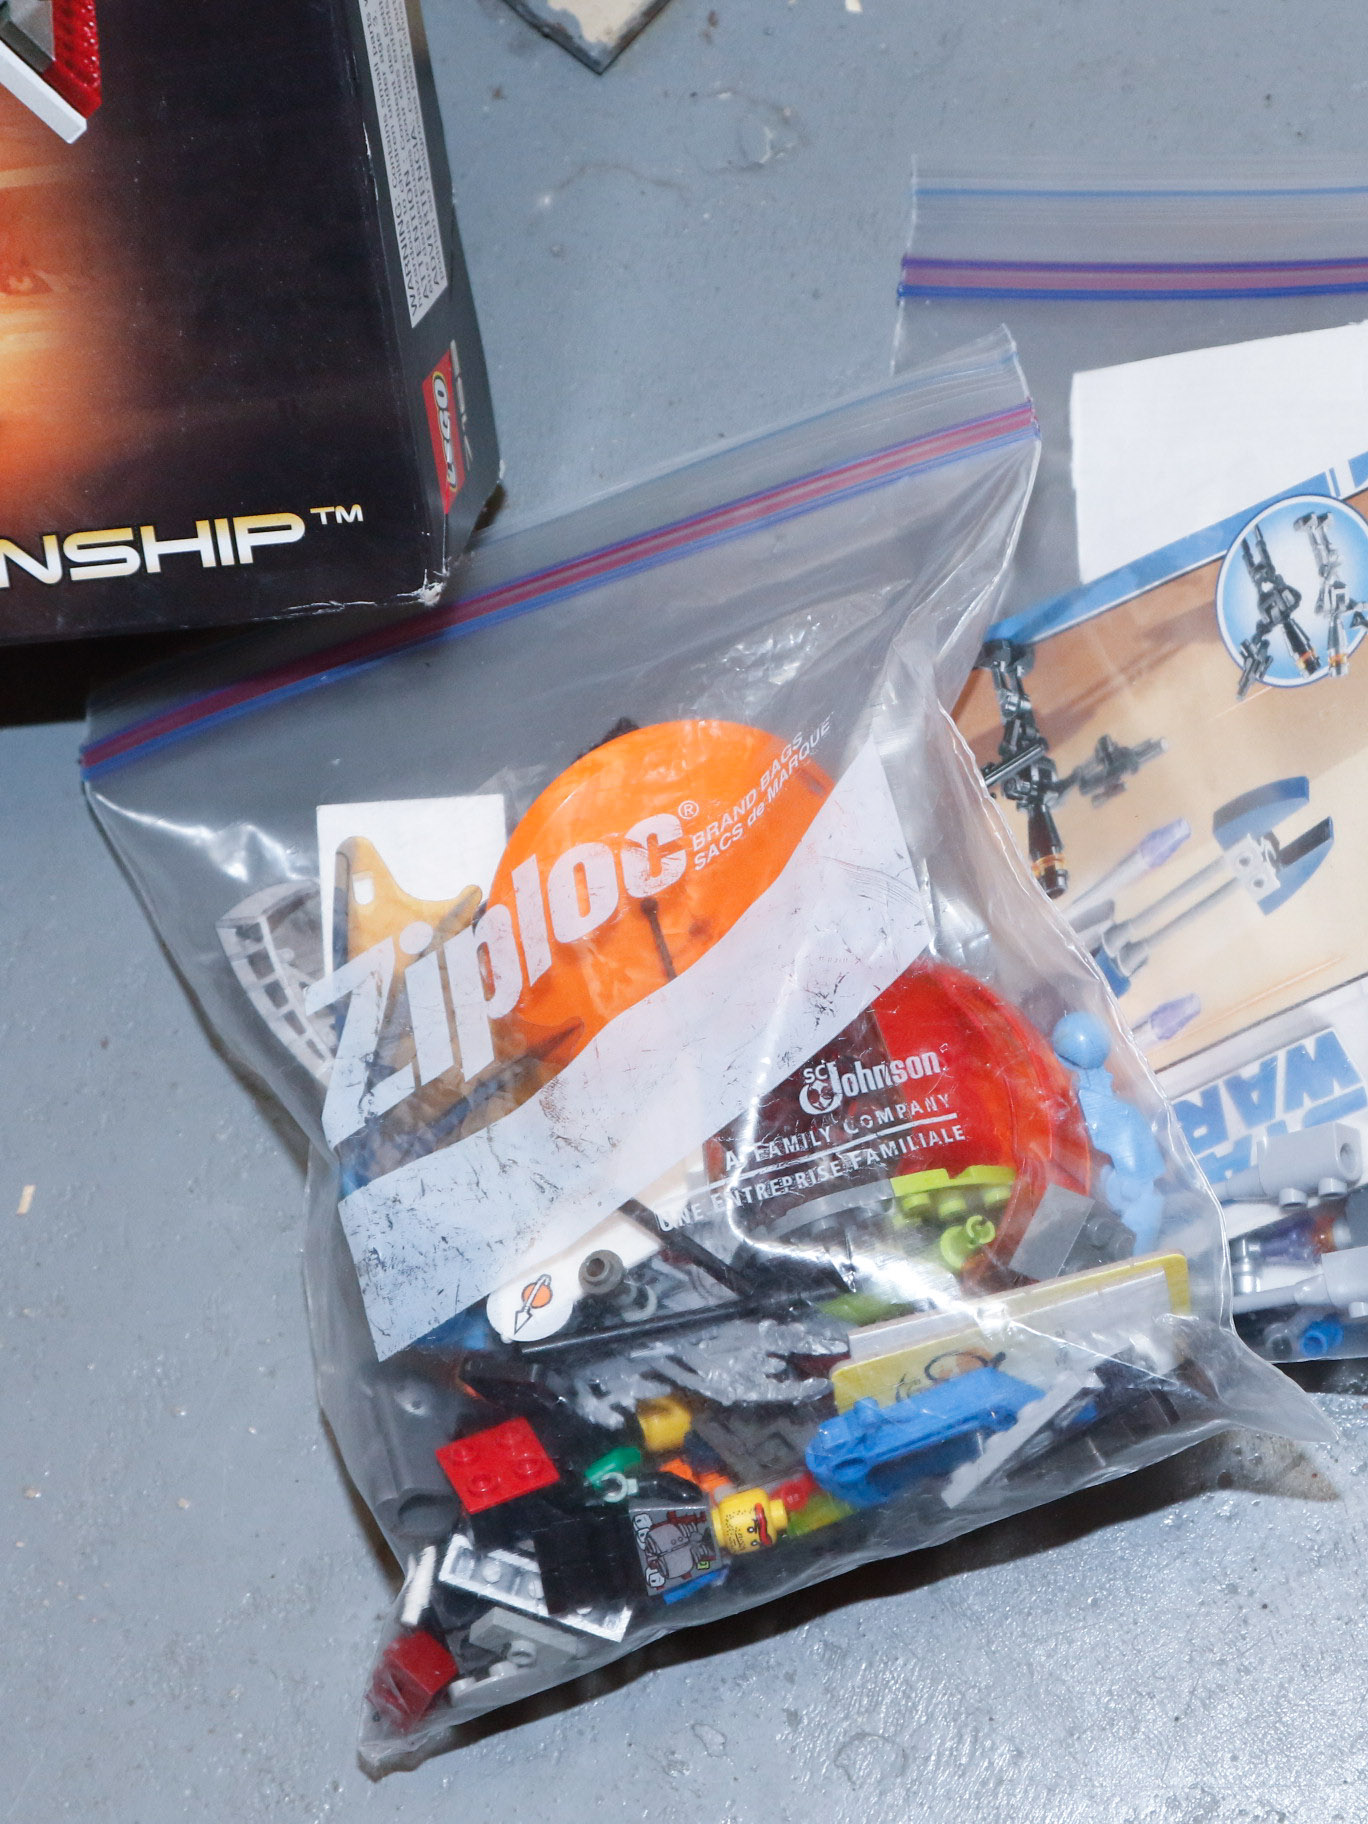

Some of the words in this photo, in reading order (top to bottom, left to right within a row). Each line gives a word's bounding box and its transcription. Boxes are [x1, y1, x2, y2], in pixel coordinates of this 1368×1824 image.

[373, 62, 385, 108] small
[691, 788, 757, 851] BRAND
[760, 732, 803, 791] BAGS
[694, 823, 743, 871] SACS
[747, 801, 765, 826] de
[767, 718, 832, 803] MARQUE
[799, 1051, 942, 1115] Johnson
[804, 1066, 828, 1085] SC
[1171, 1029, 1362, 1157] WAR
[656, 1203, 704, 1232] UNE
[710, 1158, 844, 1214] ENTREPRISE
[850, 1124, 967, 1171] FAMILIALE
[725, 1150, 742, 1172] A
[755, 1124, 833, 1163] FAMILY
[844, 1093, 952, 1135] COMPANY
